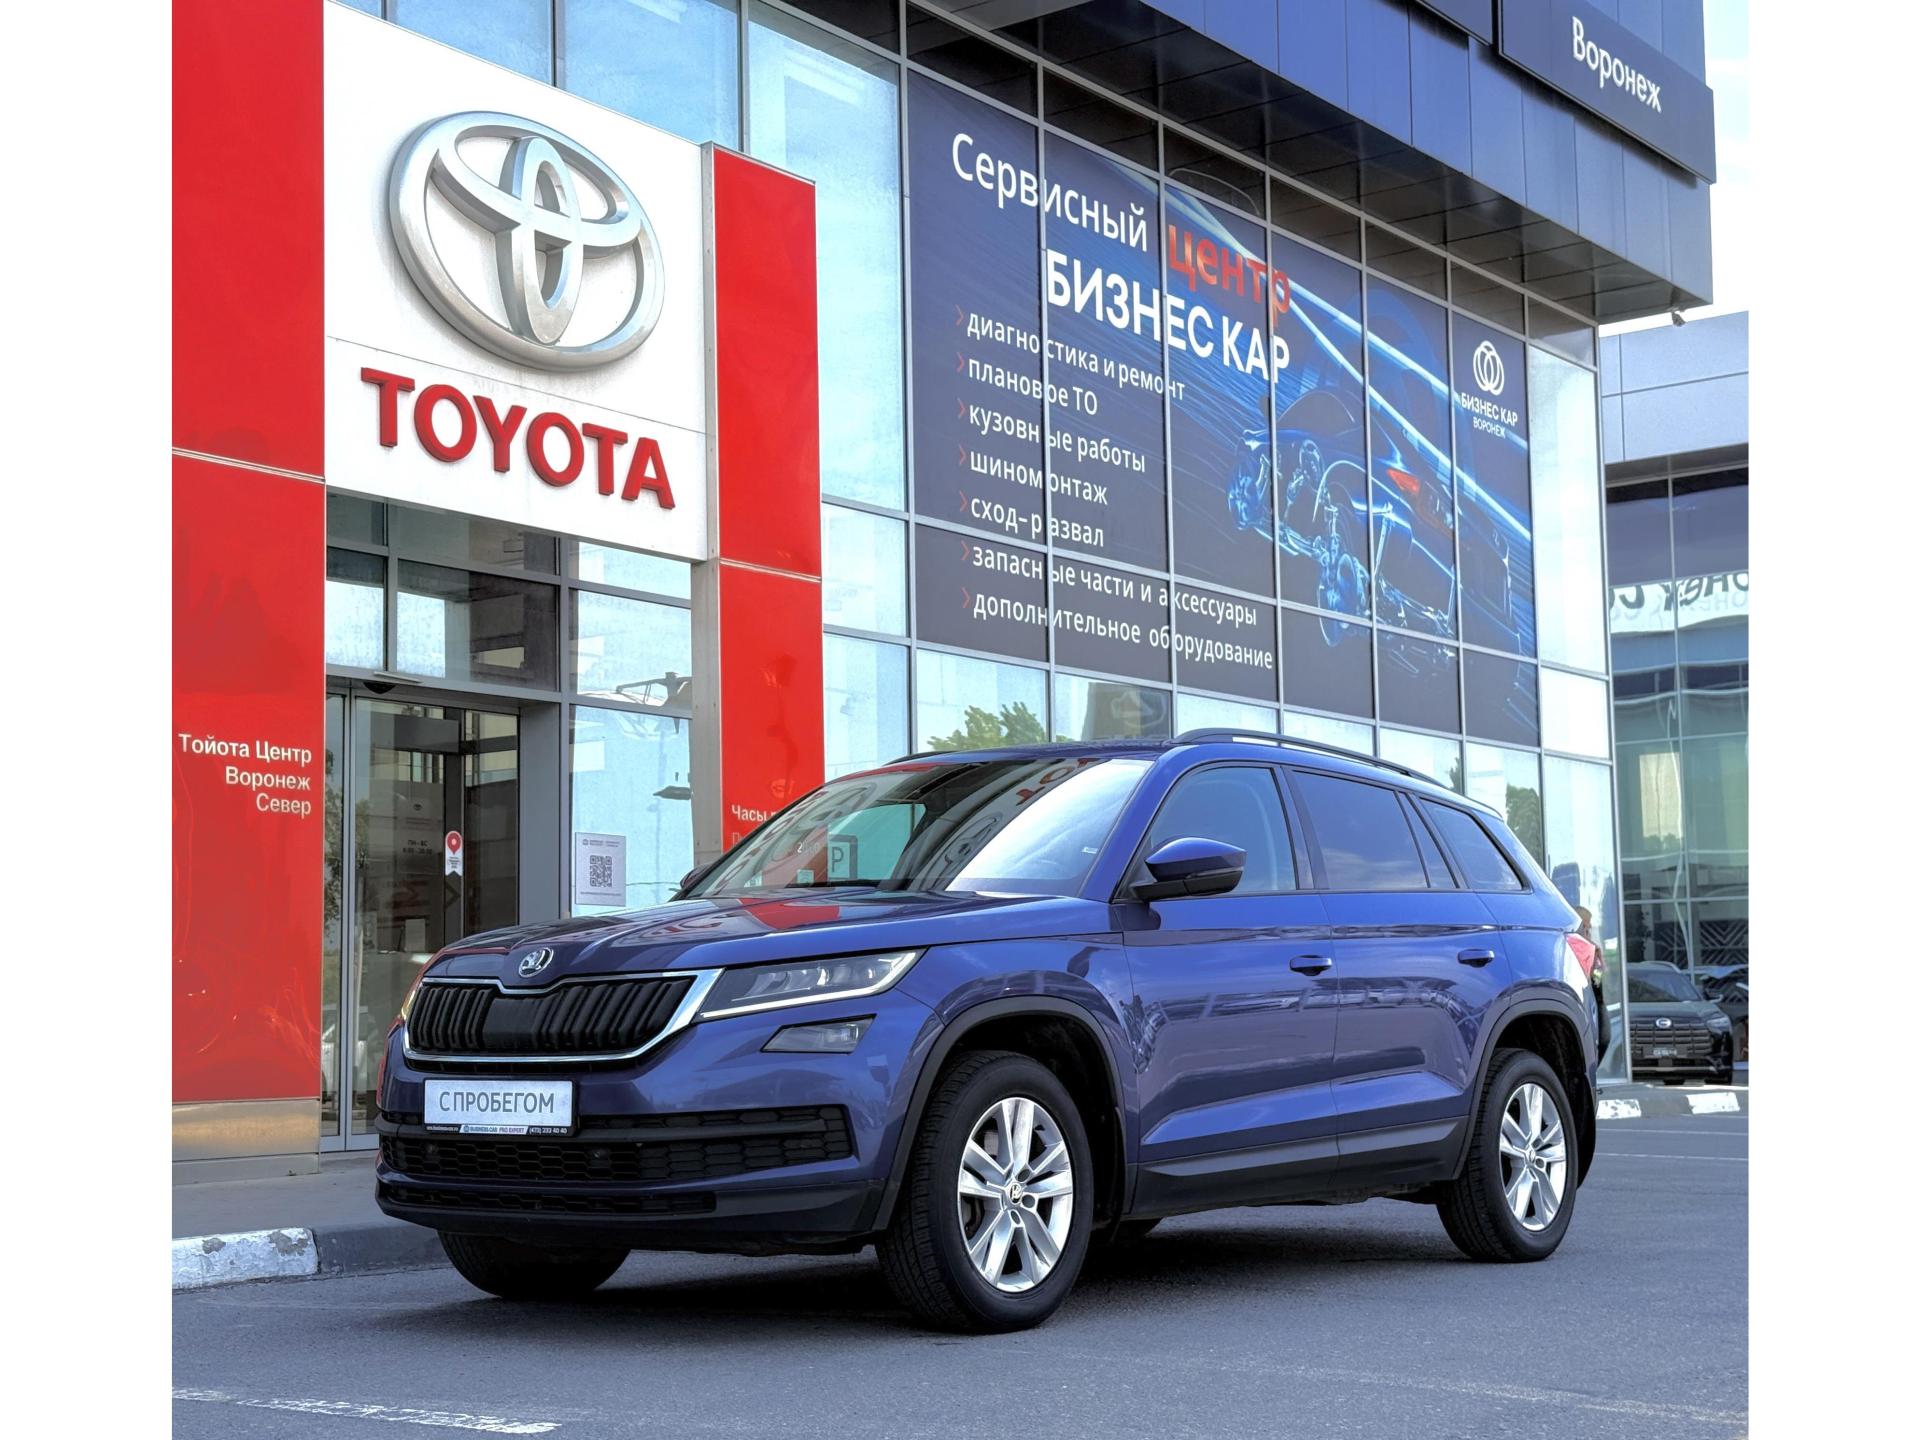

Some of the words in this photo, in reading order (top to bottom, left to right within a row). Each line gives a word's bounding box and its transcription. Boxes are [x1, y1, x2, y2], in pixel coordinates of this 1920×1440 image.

[1571, 16, 1662, 113] Воронеж
[951, 132, 1149, 253] Сервисный
[1167, 223, 1291, 329] центр
[1046, 248, 1214, 359] БИЗНЕС
[1222, 315, 1291, 385] КАР
[966, 310, 1099, 374] диагностика
[1104, 356, 1116, 380] и
[1118, 366, 1186, 402] ремонт
[968, 355, 1069, 408] плановое
[1072, 387, 1098, 416] ТО
[1461, 392, 1500, 420] БИЗНЕС
[1500, 407, 1518, 426] КАР
[360, 366, 676, 510] TOYOTA
[969, 402, 1073, 453] кузовные
[1077, 435, 1146, 473] работы
[1473, 417, 1505, 438] ВОРОНЕЖ
[970, 451, 1108, 507] шиномонтаж
[970, 494, 1104, 548] сход-развал
[972, 544, 1076, 587] запасные
[1080, 571, 1134, 599] части
[1140, 584, 1152, 602] и
[1159, 584, 1257, 627] аксессуары
[973, 591, 1141, 644] дополнительное
[1148, 625, 1273, 670] оборудование
[178, 732, 250, 759] Тойота
[255, 740, 312, 768] Центр
[225, 765, 311, 792] Воронеж
[256, 793, 312, 819] Север
[731, 804, 767, 822] Часы
[439, 1091, 450, 1111] С
[453, 1092, 554, 1113] ПРОБЕГОМ
